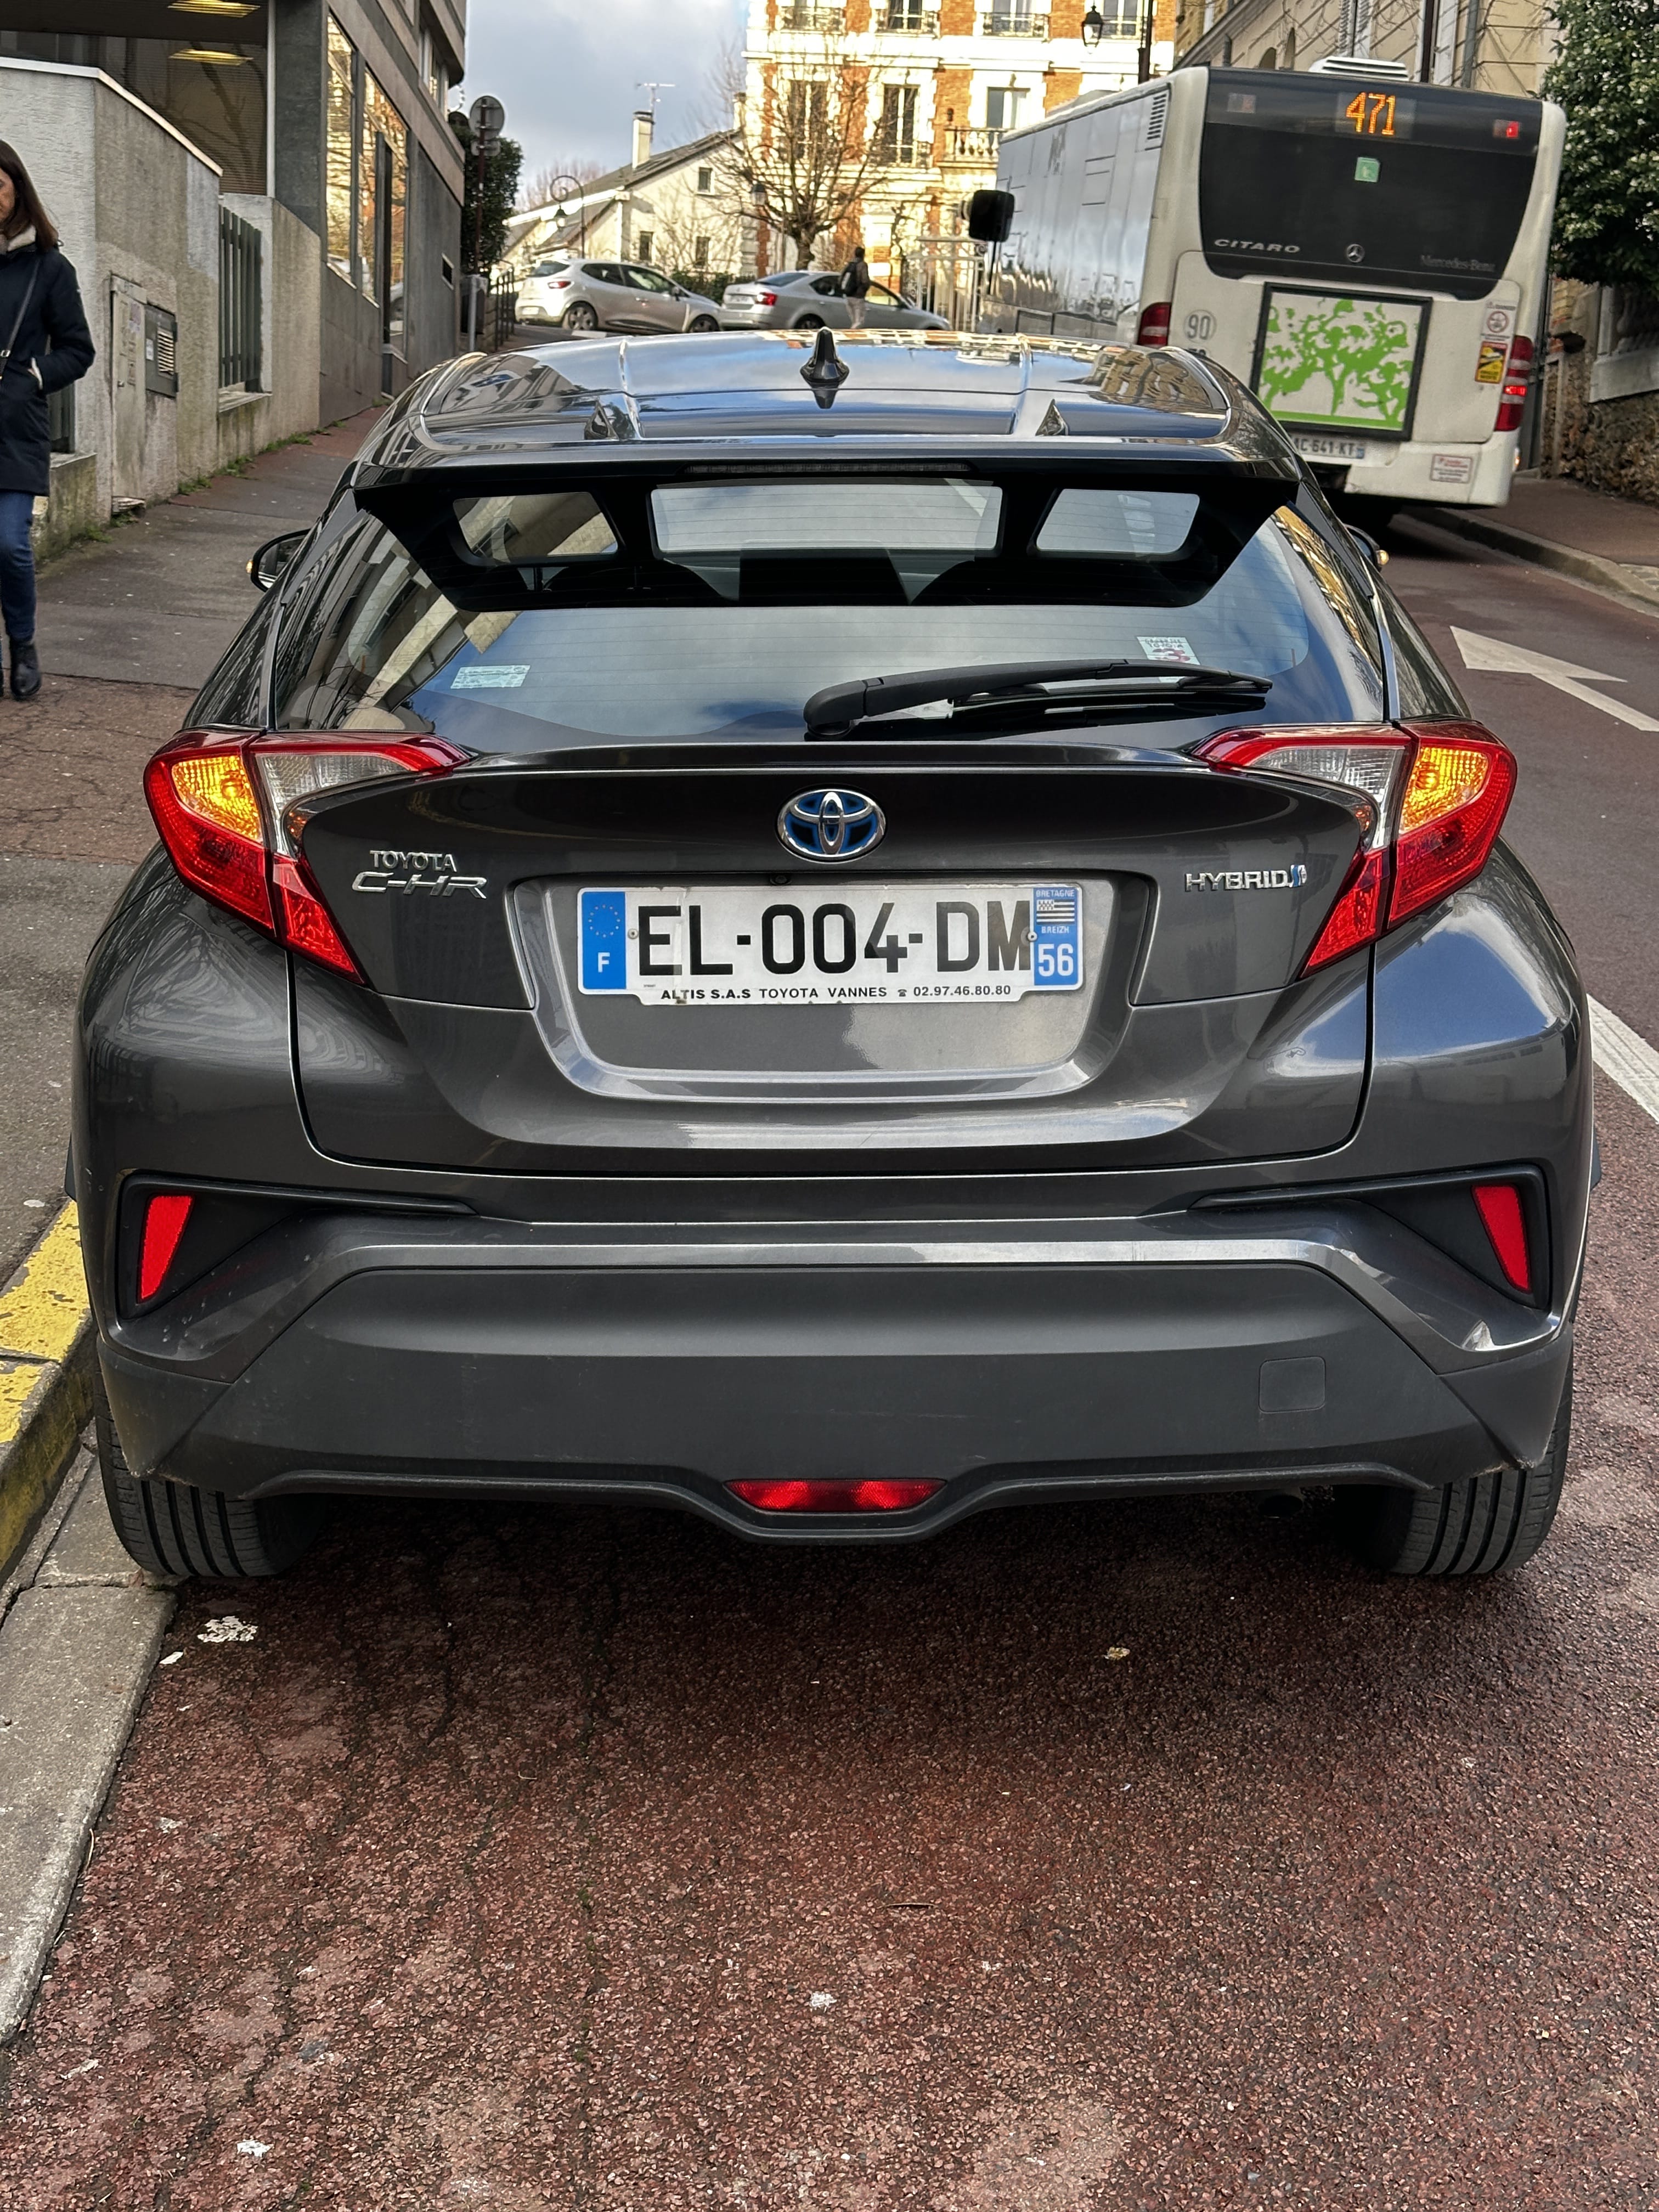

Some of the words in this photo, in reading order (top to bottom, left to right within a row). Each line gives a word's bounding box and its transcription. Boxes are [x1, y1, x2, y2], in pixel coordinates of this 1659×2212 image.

[1346, 92, 1396, 136] 471
[1214, 239, 1300, 253] CITARO
[1187, 314, 1211, 340] 90
[370, 850, 457, 872] TOYOTA
[352, 871, 487, 899] C-HR
[1185, 870, 1288, 892] HYBRID
[1036, 889, 1075, 898] BRETAGNE
[638, 900, 1031, 976] EL-004-DM
[1041, 926, 1069, 934] BREIZH
[597, 952, 611, 973] F
[1037, 943, 1074, 977] 56
[661, 989, 706, 1000] ALTIS
[710, 989, 751, 999] S.A.S
[759, 988, 819, 999] TOYOTA
[827, 987, 888, 998] VANNES
[913, 985, 1011, 997] 02.97.46.80.80
